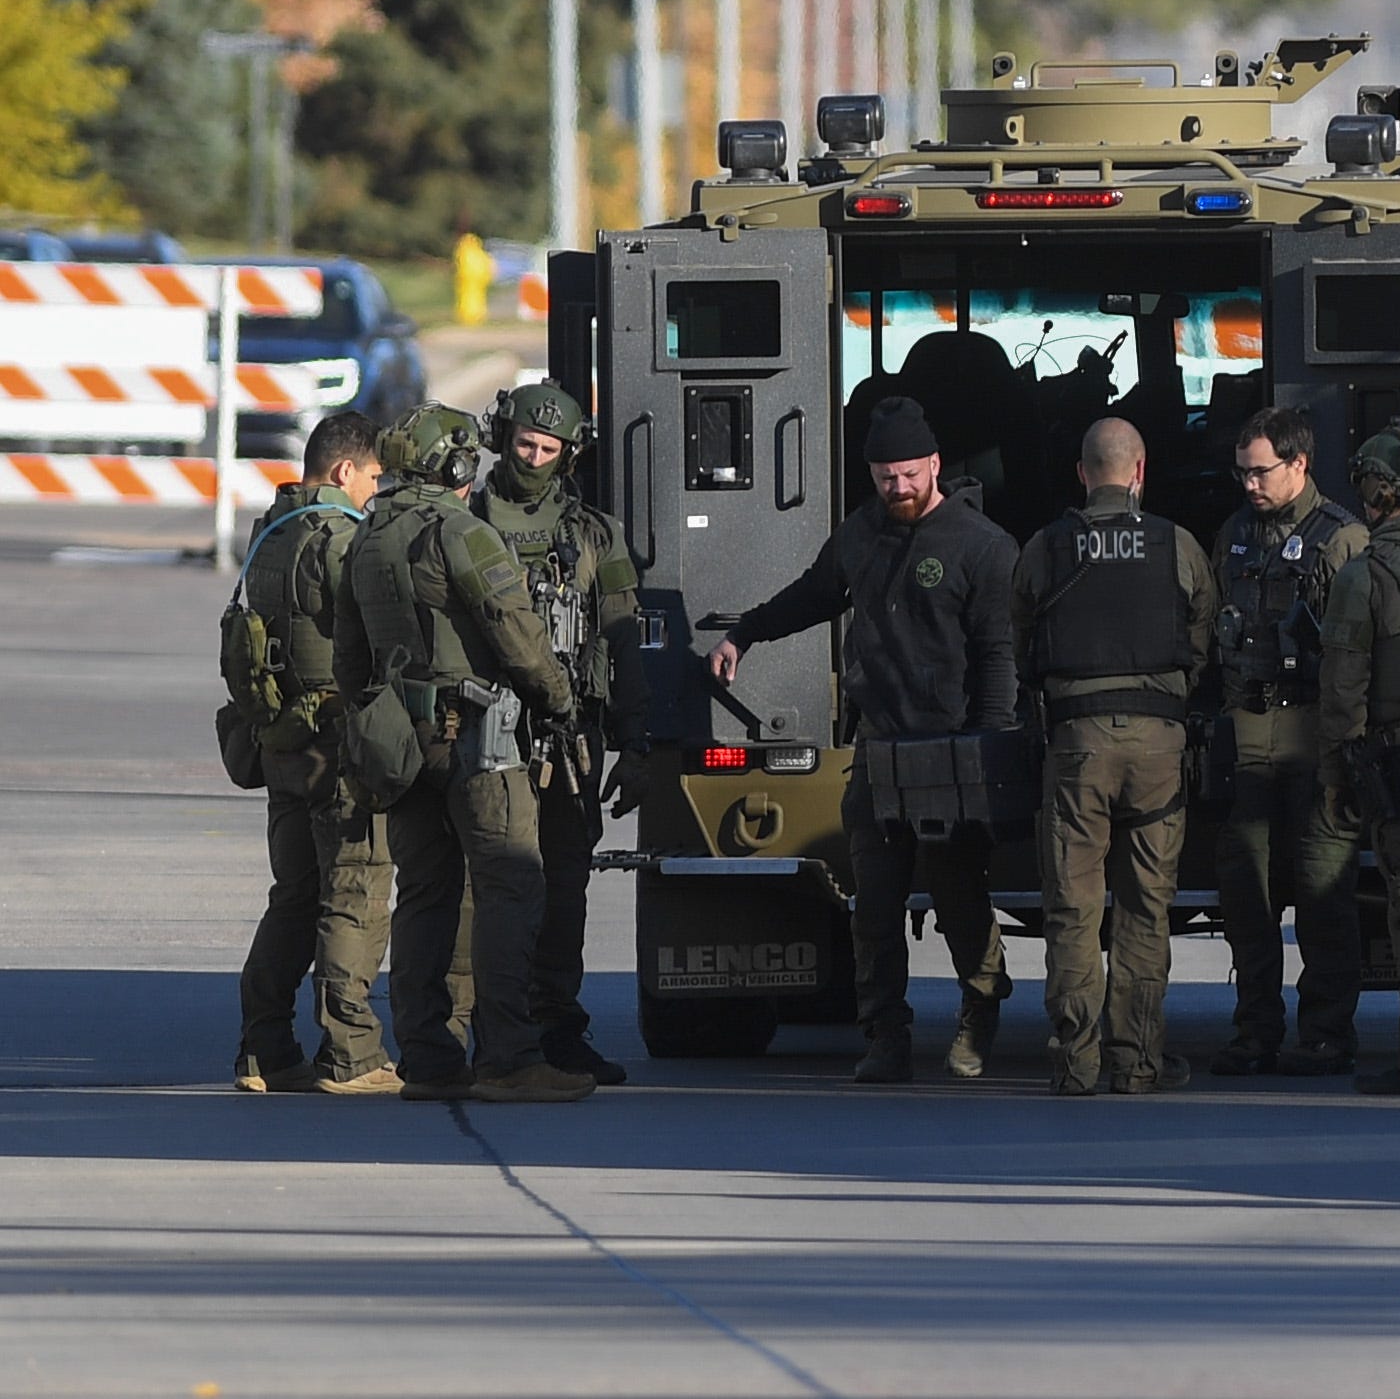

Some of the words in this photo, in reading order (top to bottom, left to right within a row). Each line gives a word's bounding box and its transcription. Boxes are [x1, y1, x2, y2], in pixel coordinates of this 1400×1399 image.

[507, 529, 549, 544] POLICE
[1076, 529, 1146, 562] POLICE
[657, 941, 817, 974] LENCO
[660, 974, 728, 988] ARMORED
[747, 972, 816, 986] VEHICLES
